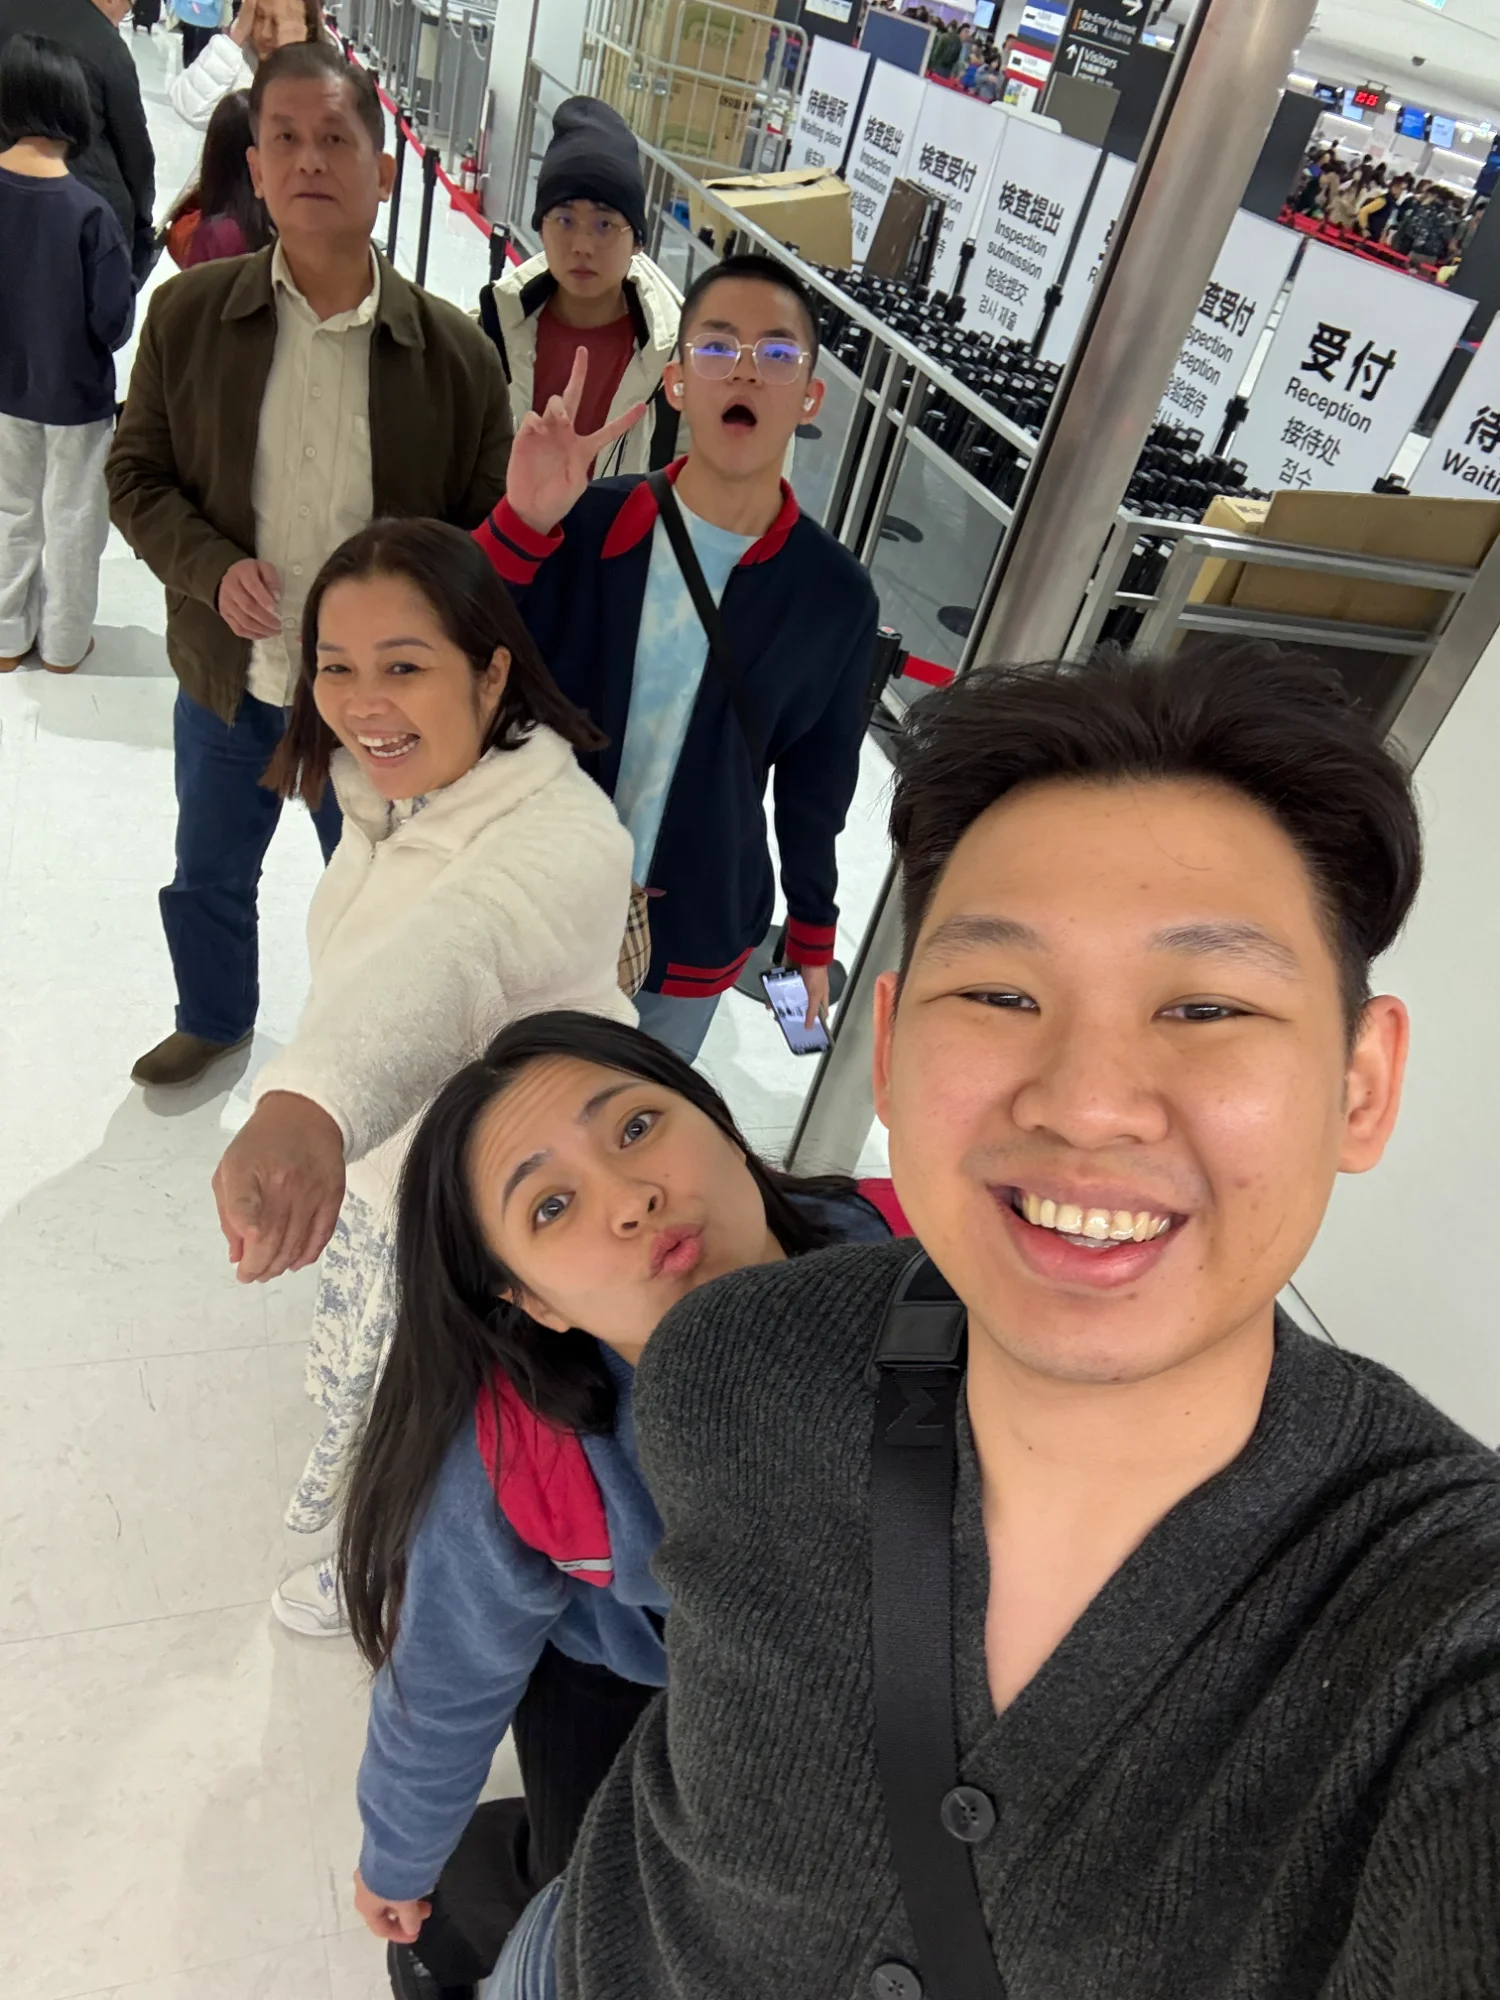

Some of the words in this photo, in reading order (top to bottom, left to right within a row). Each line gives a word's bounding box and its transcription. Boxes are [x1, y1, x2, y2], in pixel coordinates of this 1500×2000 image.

[1078, 21, 1098, 35] SOFA
[1082, 9, 1112, 29] Re-Entry
[1112, 19, 1137, 36] Permit
[1084, 48, 1118, 70] Visitors
[823, 130, 842, 148] place
[853, 167, 887, 196] submission
[860, 147, 891, 177] Inspection
[919, 142, 977, 193] 検査受付
[998, 180, 1065, 236] 検査提出
[995, 218, 1048, 258] Inspection
[987, 240, 1042, 280] submission
[1198, 282, 1257, 337] 査受付
[1186, 325, 1234, 363] spection
[1301, 321, 1397, 401] 受付
[1179, 350, 1221, 385] ception
[1285, 376, 1372, 434] Reception
[1280, 416, 1341, 467] 接待处
[1464, 405, 1500, 454] 待
[1278, 457, 1313, 490] 접수
[1442, 448, 1500, 496] Waiti
